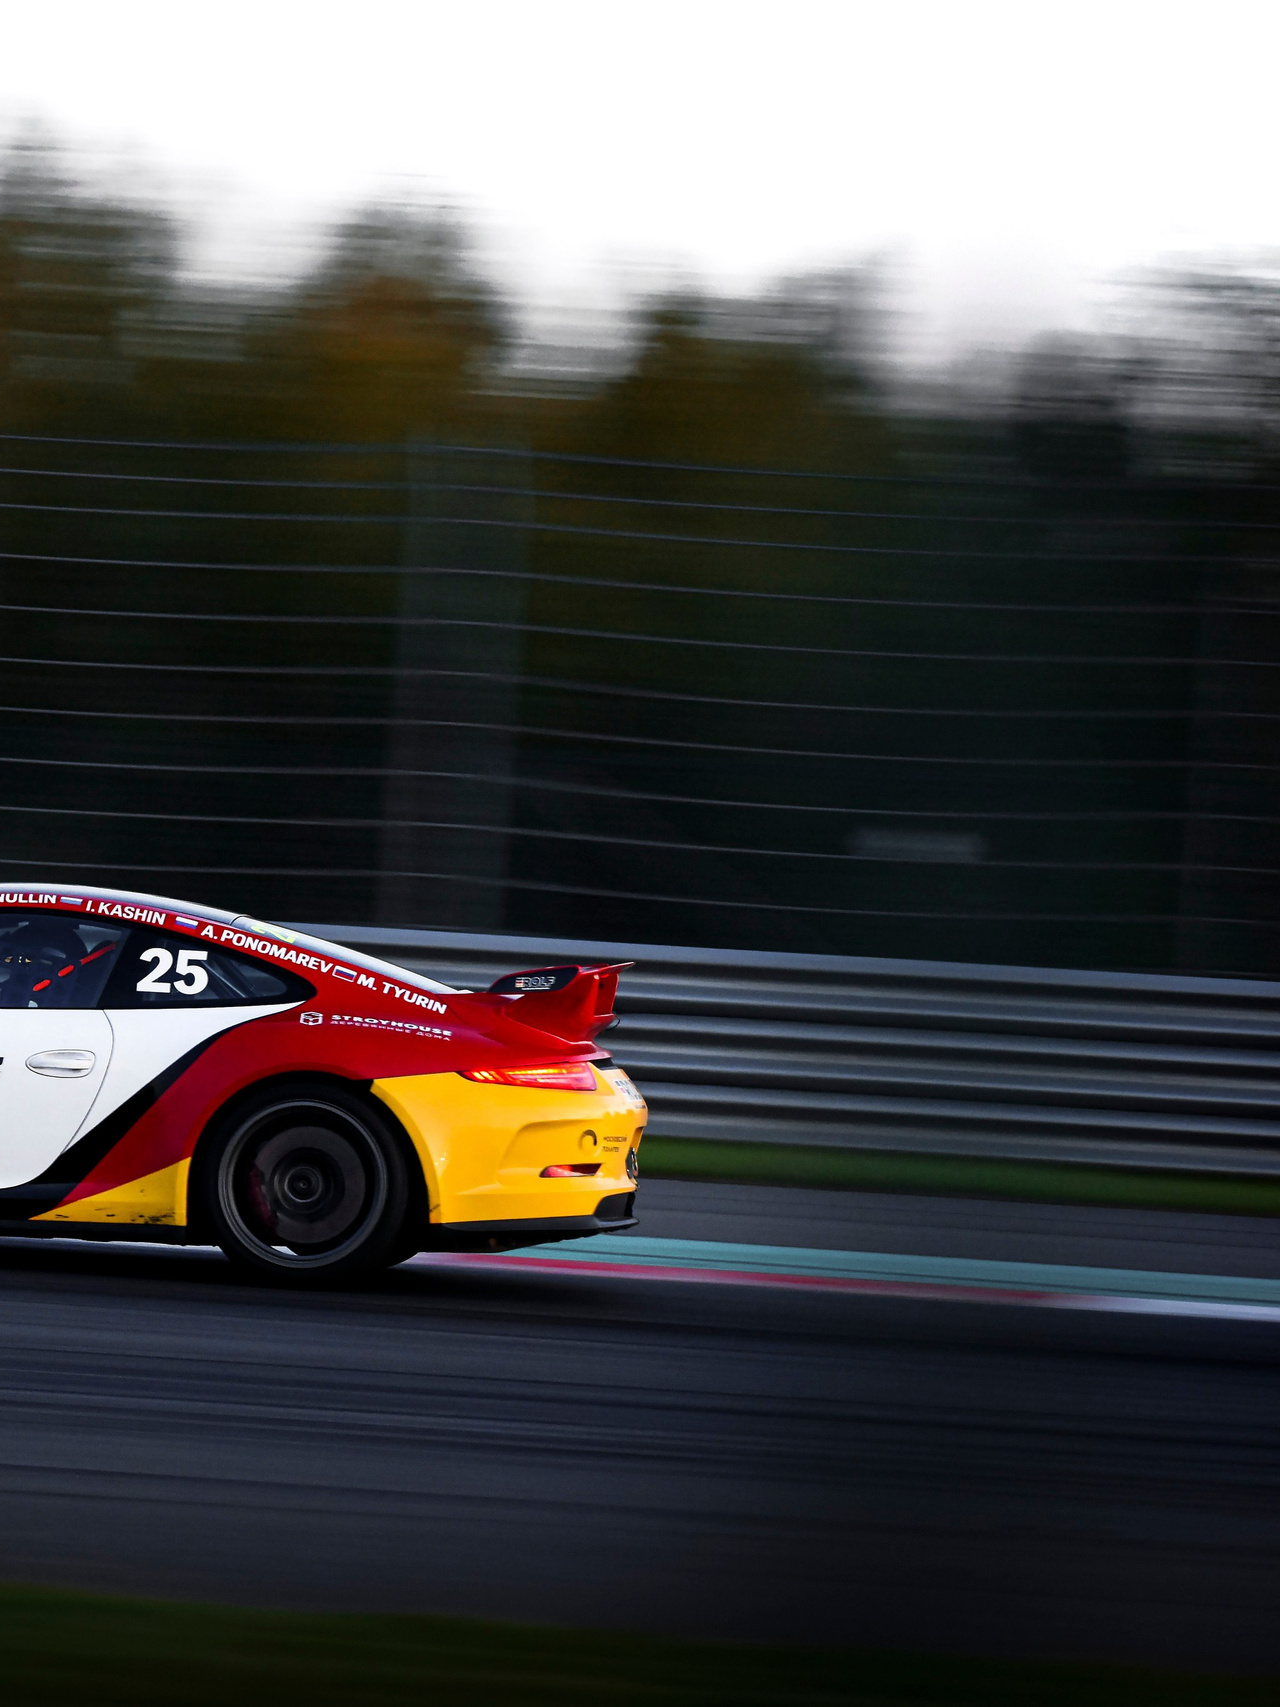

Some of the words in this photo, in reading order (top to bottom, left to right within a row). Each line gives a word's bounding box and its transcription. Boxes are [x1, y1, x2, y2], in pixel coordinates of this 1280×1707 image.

[86, 901, 95, 912] I.
[98, 902, 166, 925] KASHIN
[200, 925, 218, 940] A.
[220, 931, 334, 973] PONOMAREV
[136, 947, 209, 995] 25
[356, 974, 377, 991] M.
[382, 981, 447, 1015] TYURIN
[331, 1014, 453, 1036] STROYHOUSE
[415, 1031, 451, 1042] ДОМА
